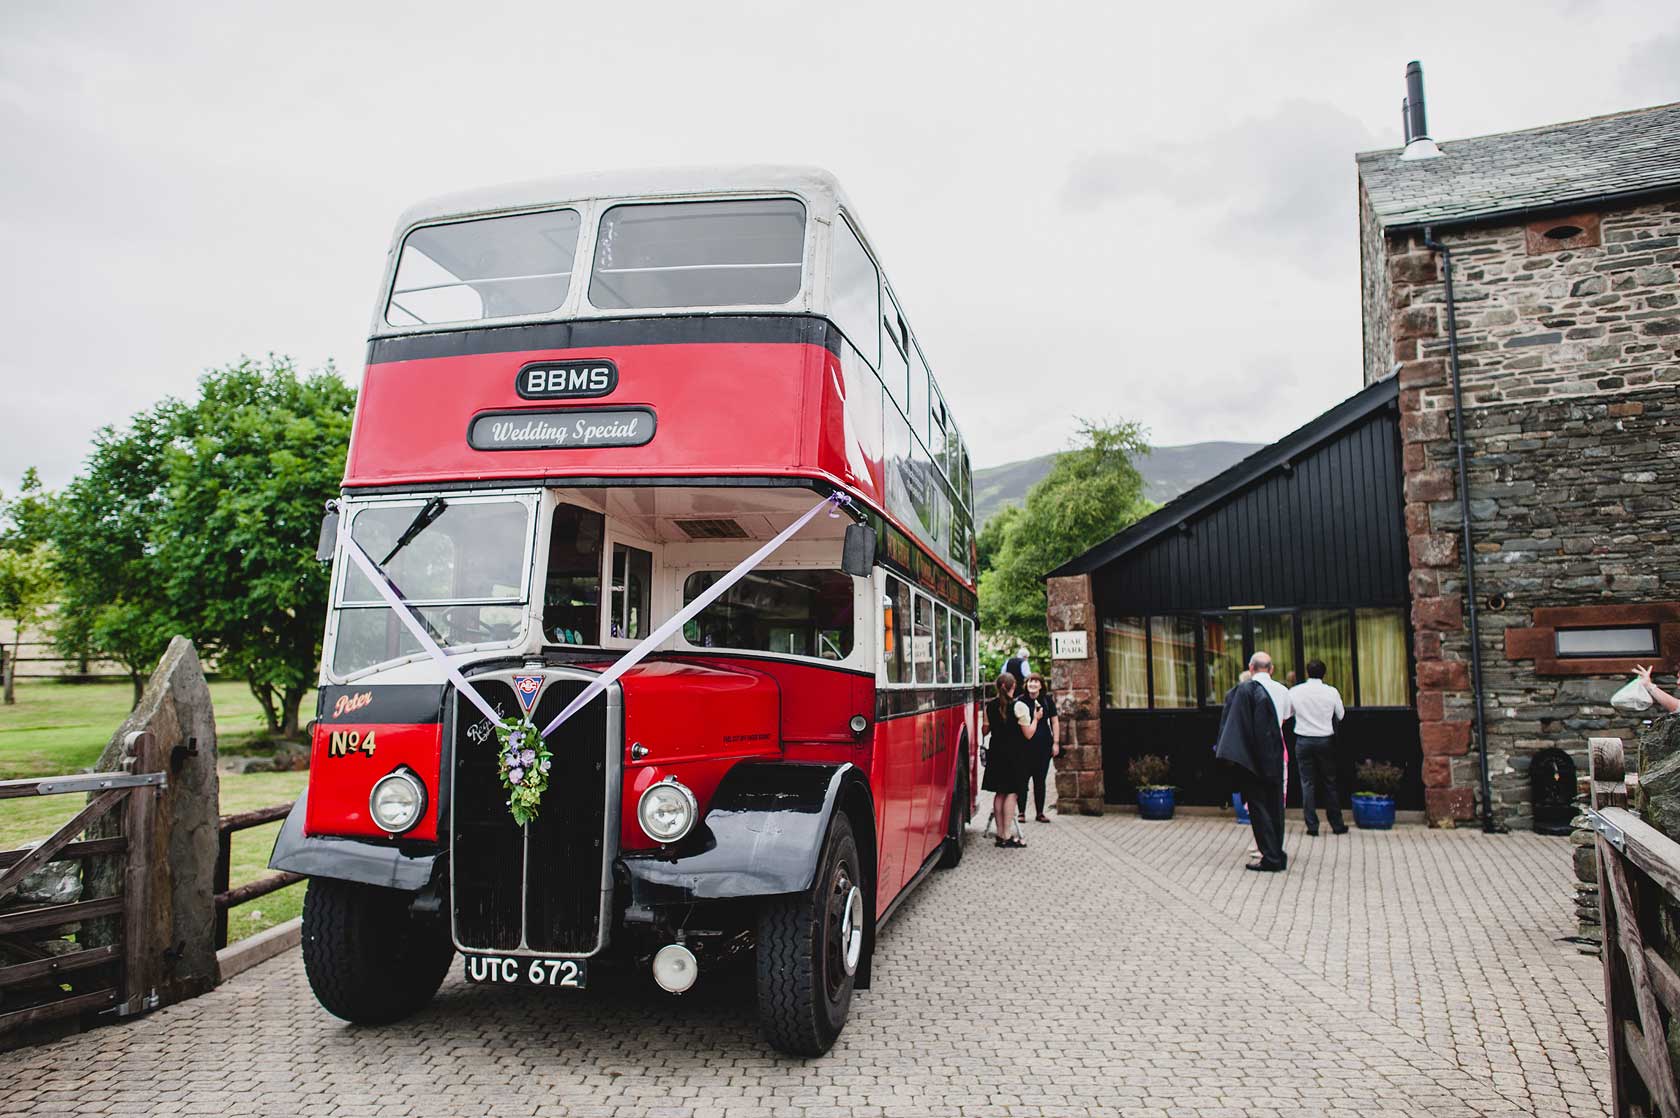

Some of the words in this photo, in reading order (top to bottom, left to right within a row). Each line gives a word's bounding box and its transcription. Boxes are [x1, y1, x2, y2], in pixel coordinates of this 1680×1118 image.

[527, 368, 609, 392] BBMS
[492, 420, 568, 444] Wedding
[572, 418, 638, 444] Special
[332, 691, 373, 718] Peter
[471, 957, 519, 983] UTC
[528, 959, 578, 986] 672
